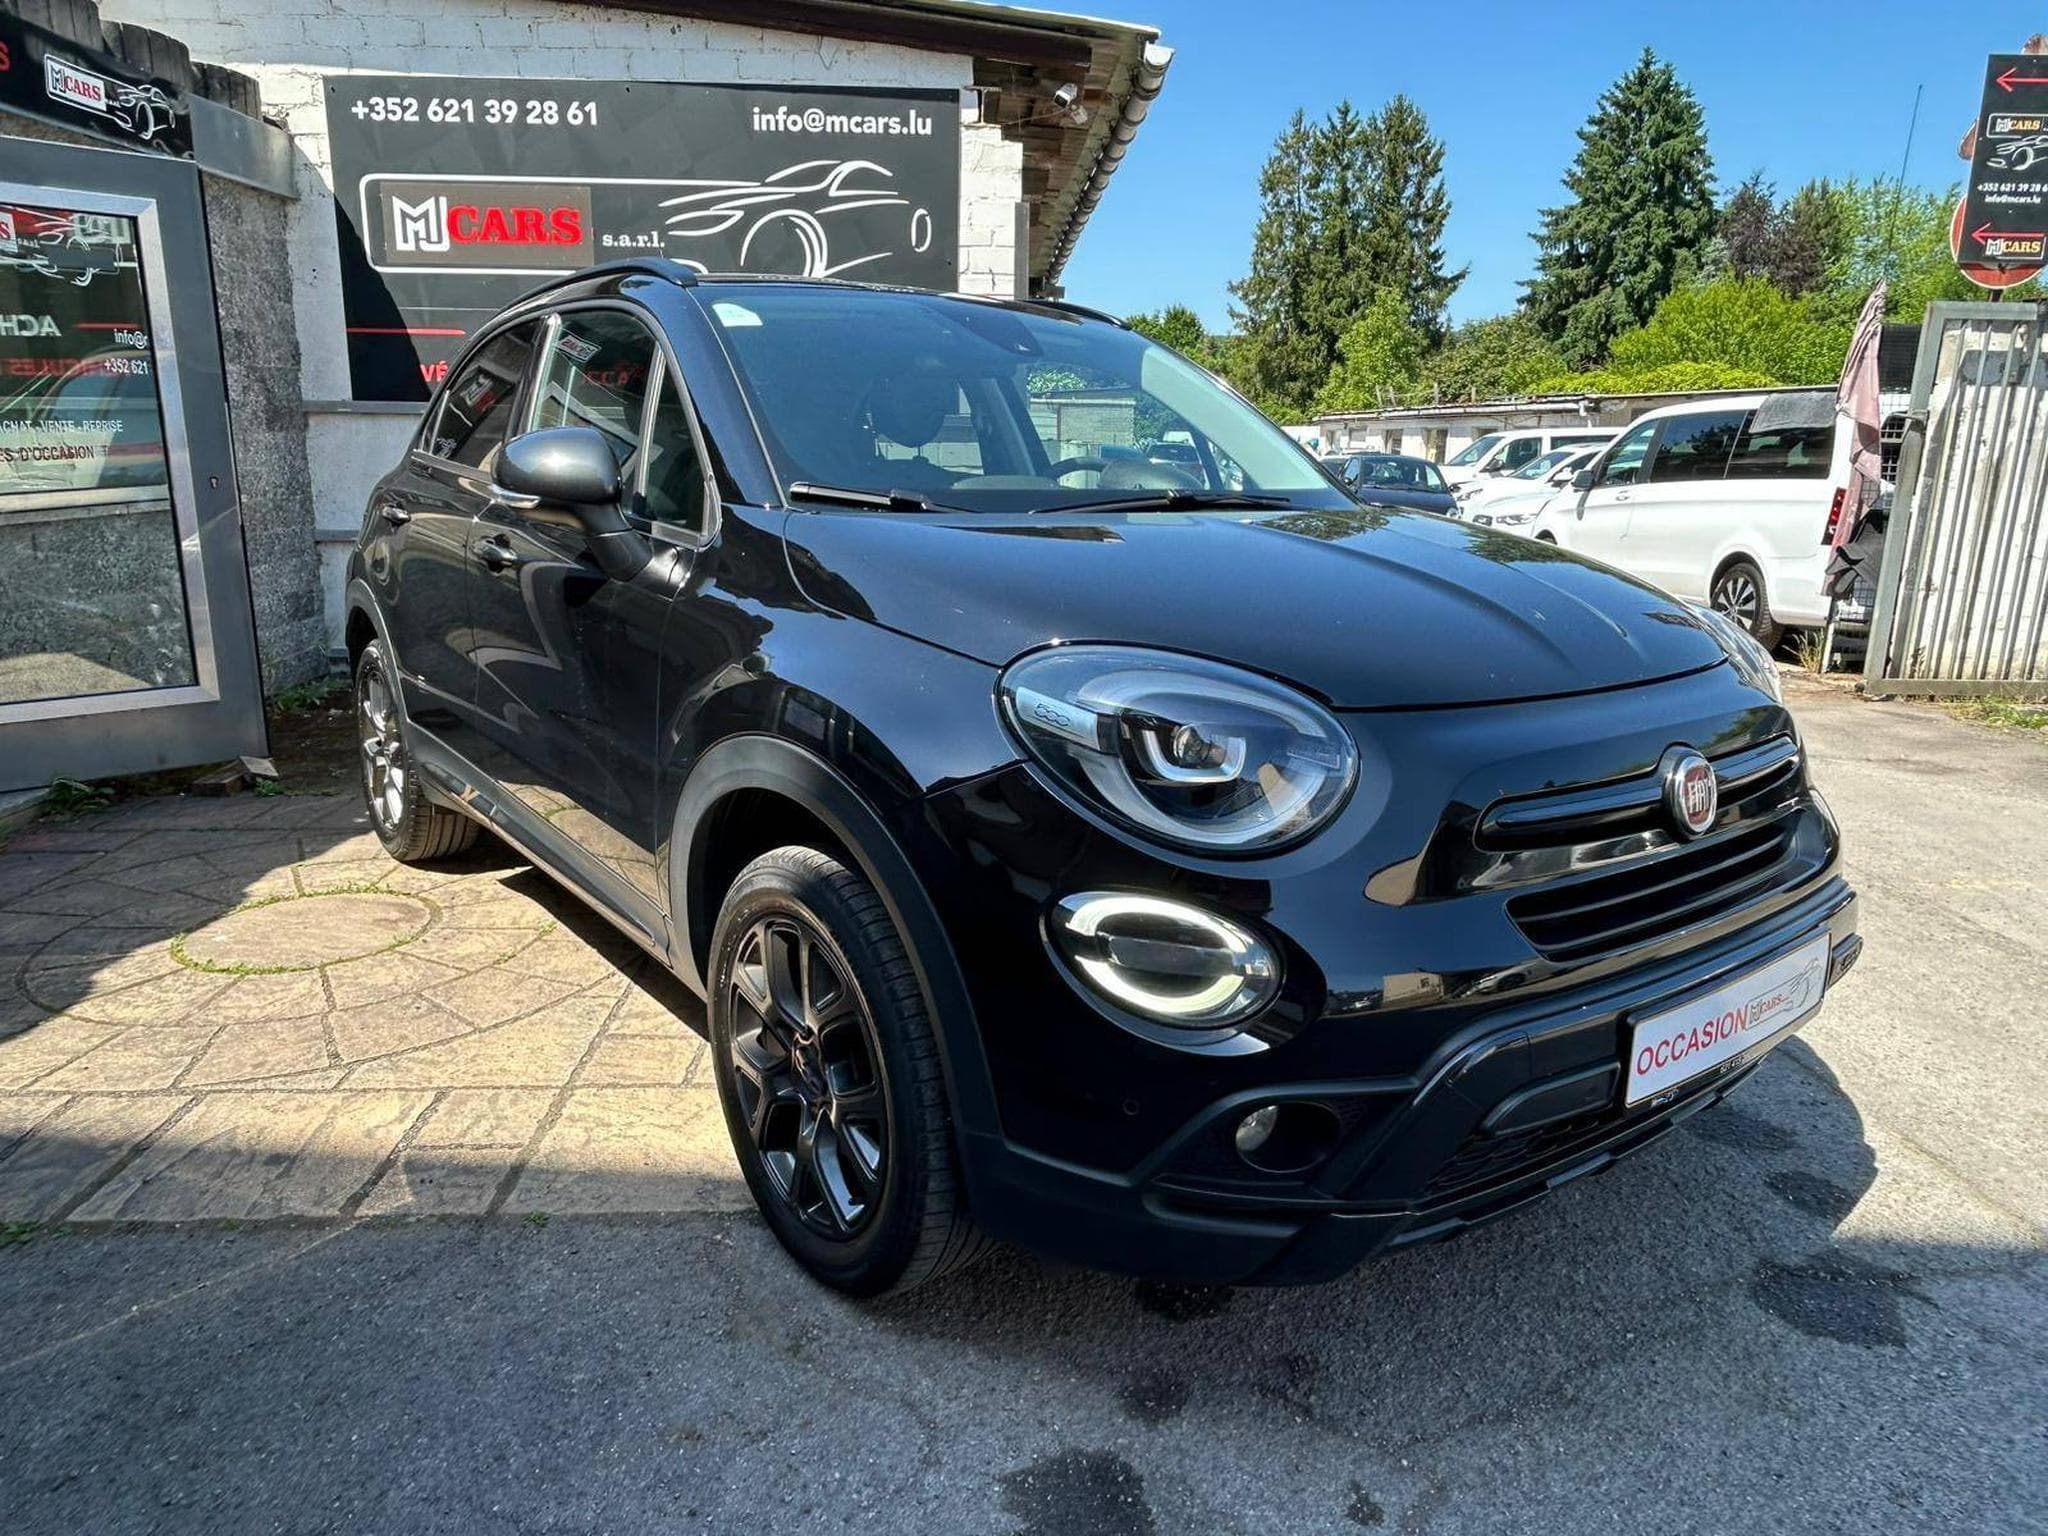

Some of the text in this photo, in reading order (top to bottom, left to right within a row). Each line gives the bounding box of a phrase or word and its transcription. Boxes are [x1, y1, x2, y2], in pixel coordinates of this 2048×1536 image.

[351, 96, 598, 126] +352 621 39 28 61
[752, 106, 933, 136] info@mcars.lu
[447, 204, 583, 246] CARS
[602, 229, 665, 249] s.a.r.l.
[2003, 241, 2041, 253] CARS
[104, 358, 129, 374] +352
[131, 360, 149, 375] 621
[40, 420, 75, 433] VENTE
[82, 419, 124, 433] REPRISE
[1636, 1003, 1749, 1076] OCCASION
